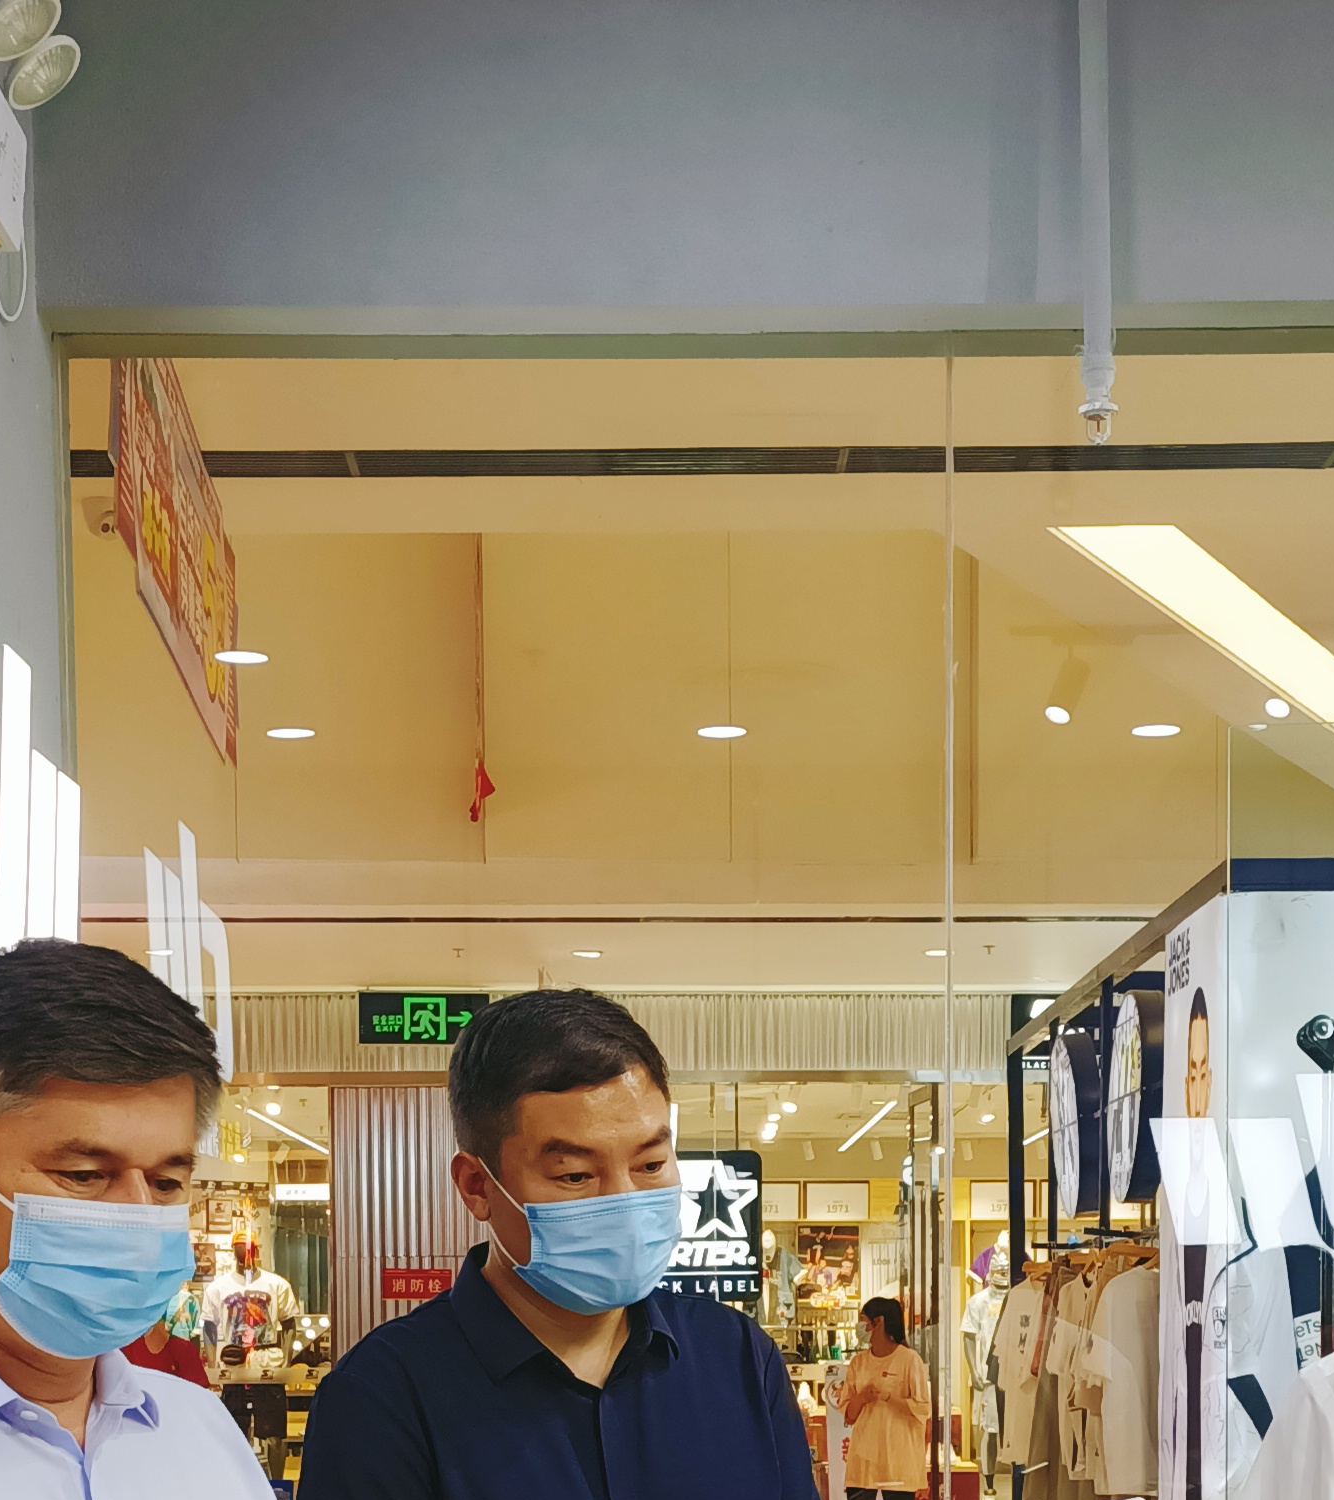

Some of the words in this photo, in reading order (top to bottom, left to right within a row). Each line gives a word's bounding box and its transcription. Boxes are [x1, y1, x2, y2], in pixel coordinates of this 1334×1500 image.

[1169, 927, 1190, 967] JACK&
[1168, 957, 1190, 997] JONES
[826, 1204, 850, 1214] 1971
[990, 1203, 1008, 1213] 197
[668, 1240, 751, 1267] RTER
[392, 1278, 443, 1293] 消防栓
[695, 1280, 760, 1293] LABEL
